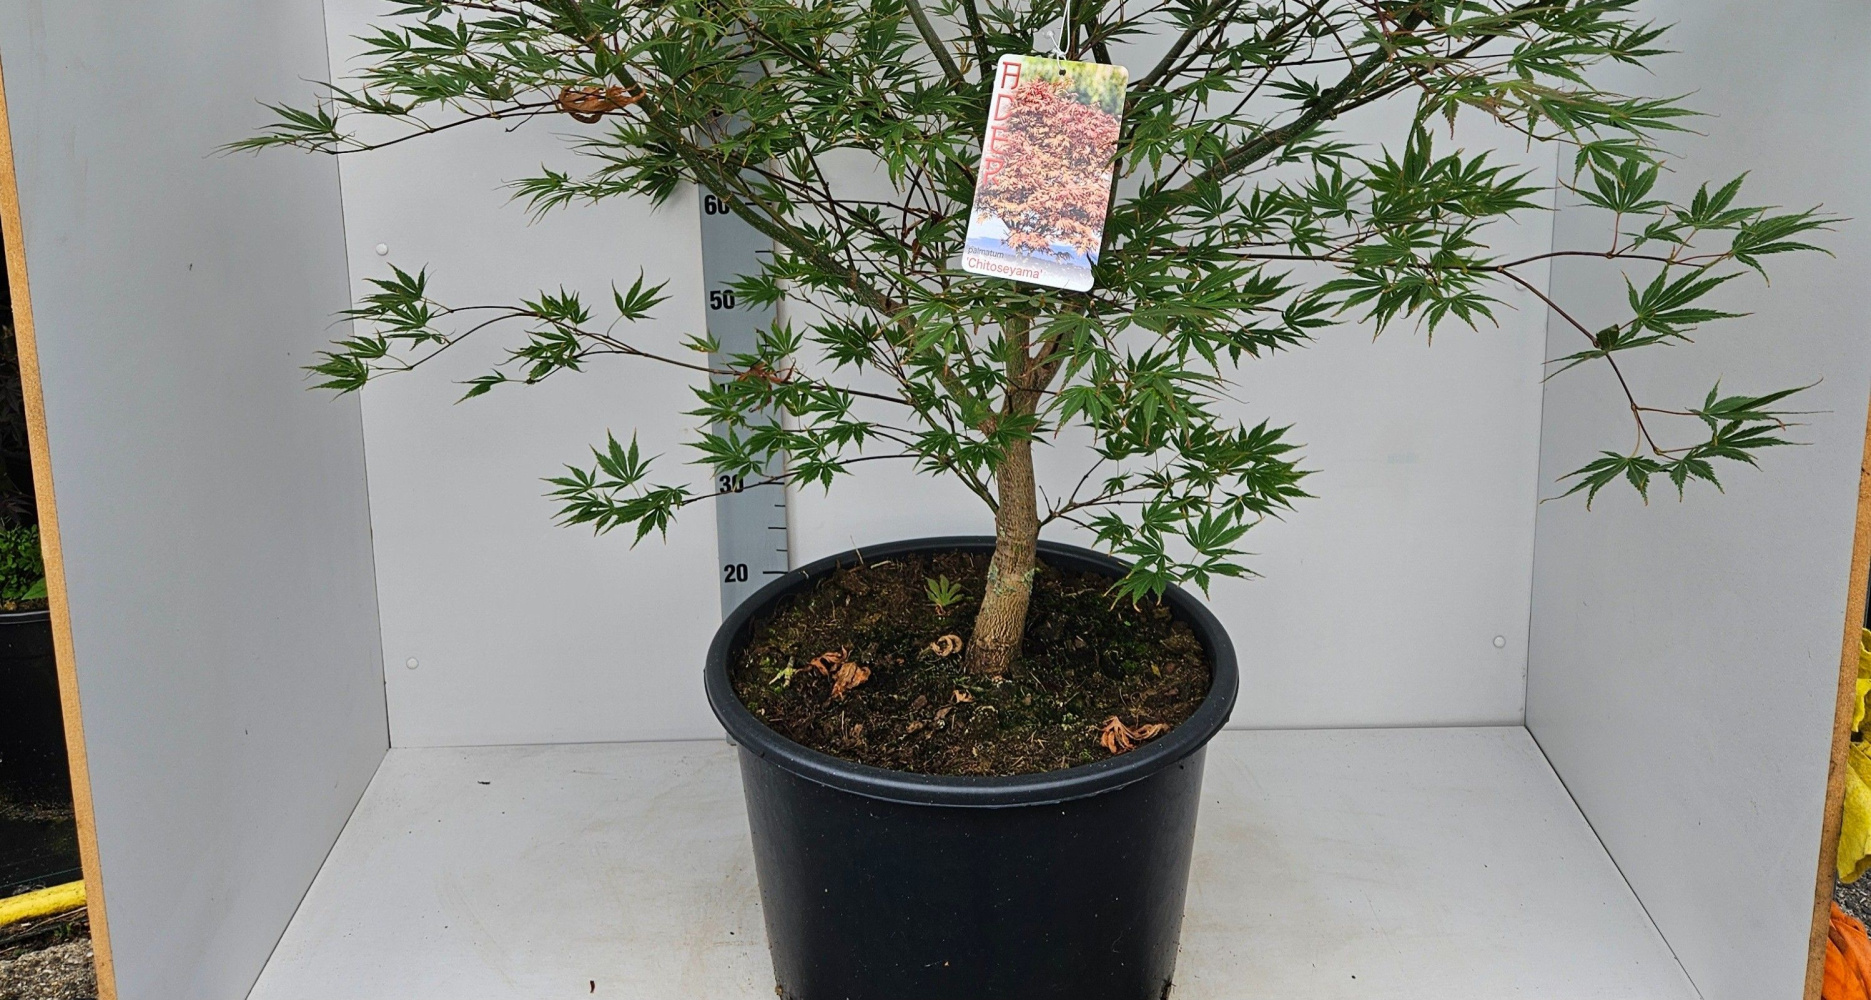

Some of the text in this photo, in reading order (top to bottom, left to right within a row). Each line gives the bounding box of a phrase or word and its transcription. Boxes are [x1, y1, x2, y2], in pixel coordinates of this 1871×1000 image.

[704, 195, 731, 216] 60
[967, 246, 1005, 259] palmatum
[966, 256, 1043, 279] 'Chitoseyama'
[709, 289, 736, 310] 50
[718, 475, 745, 495] 30
[723, 563, 749, 583] 20
